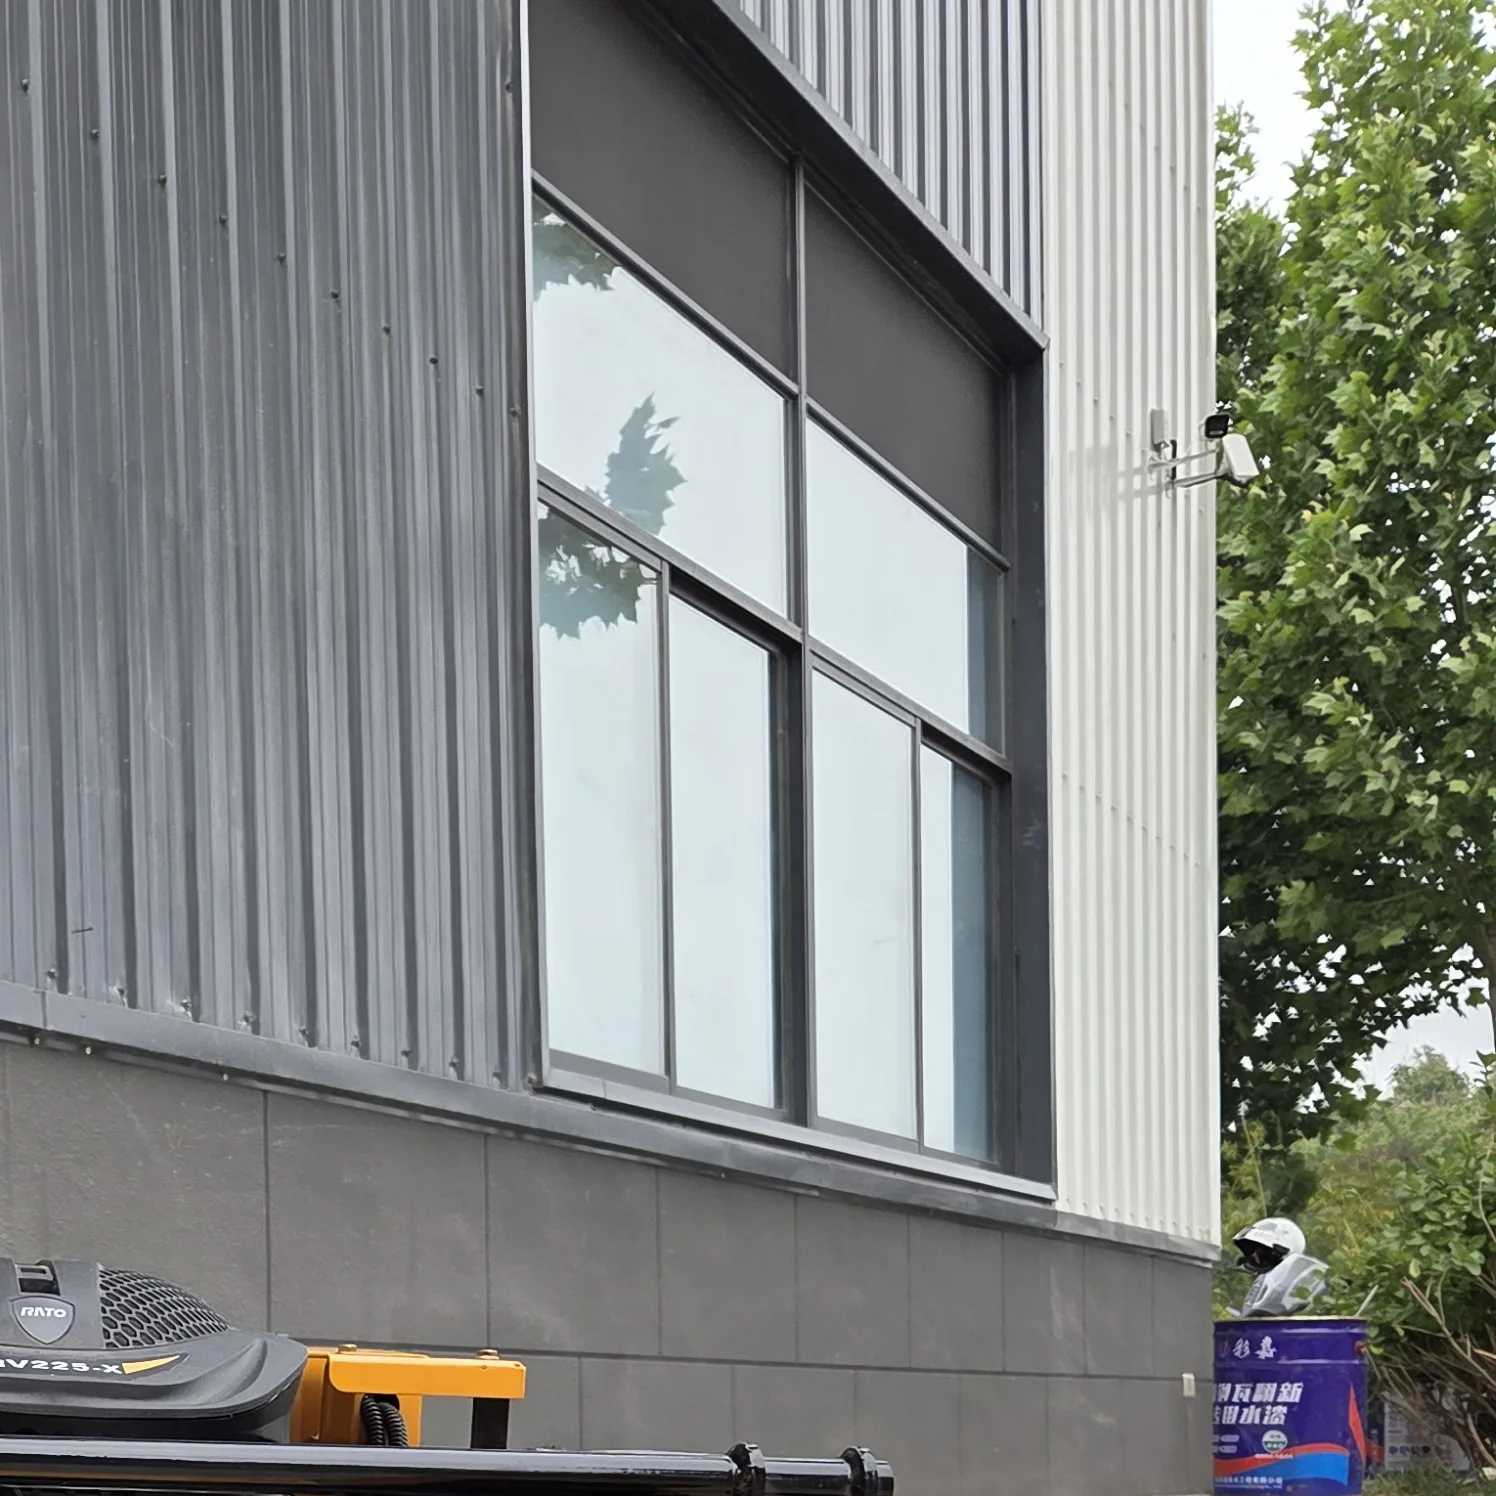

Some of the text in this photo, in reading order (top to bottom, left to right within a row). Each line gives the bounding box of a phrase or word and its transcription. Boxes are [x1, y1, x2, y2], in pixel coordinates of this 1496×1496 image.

[20, 1306, 67, 1318] RATO
[1213, 1382, 1304, 1403] 钢瓦翻新
